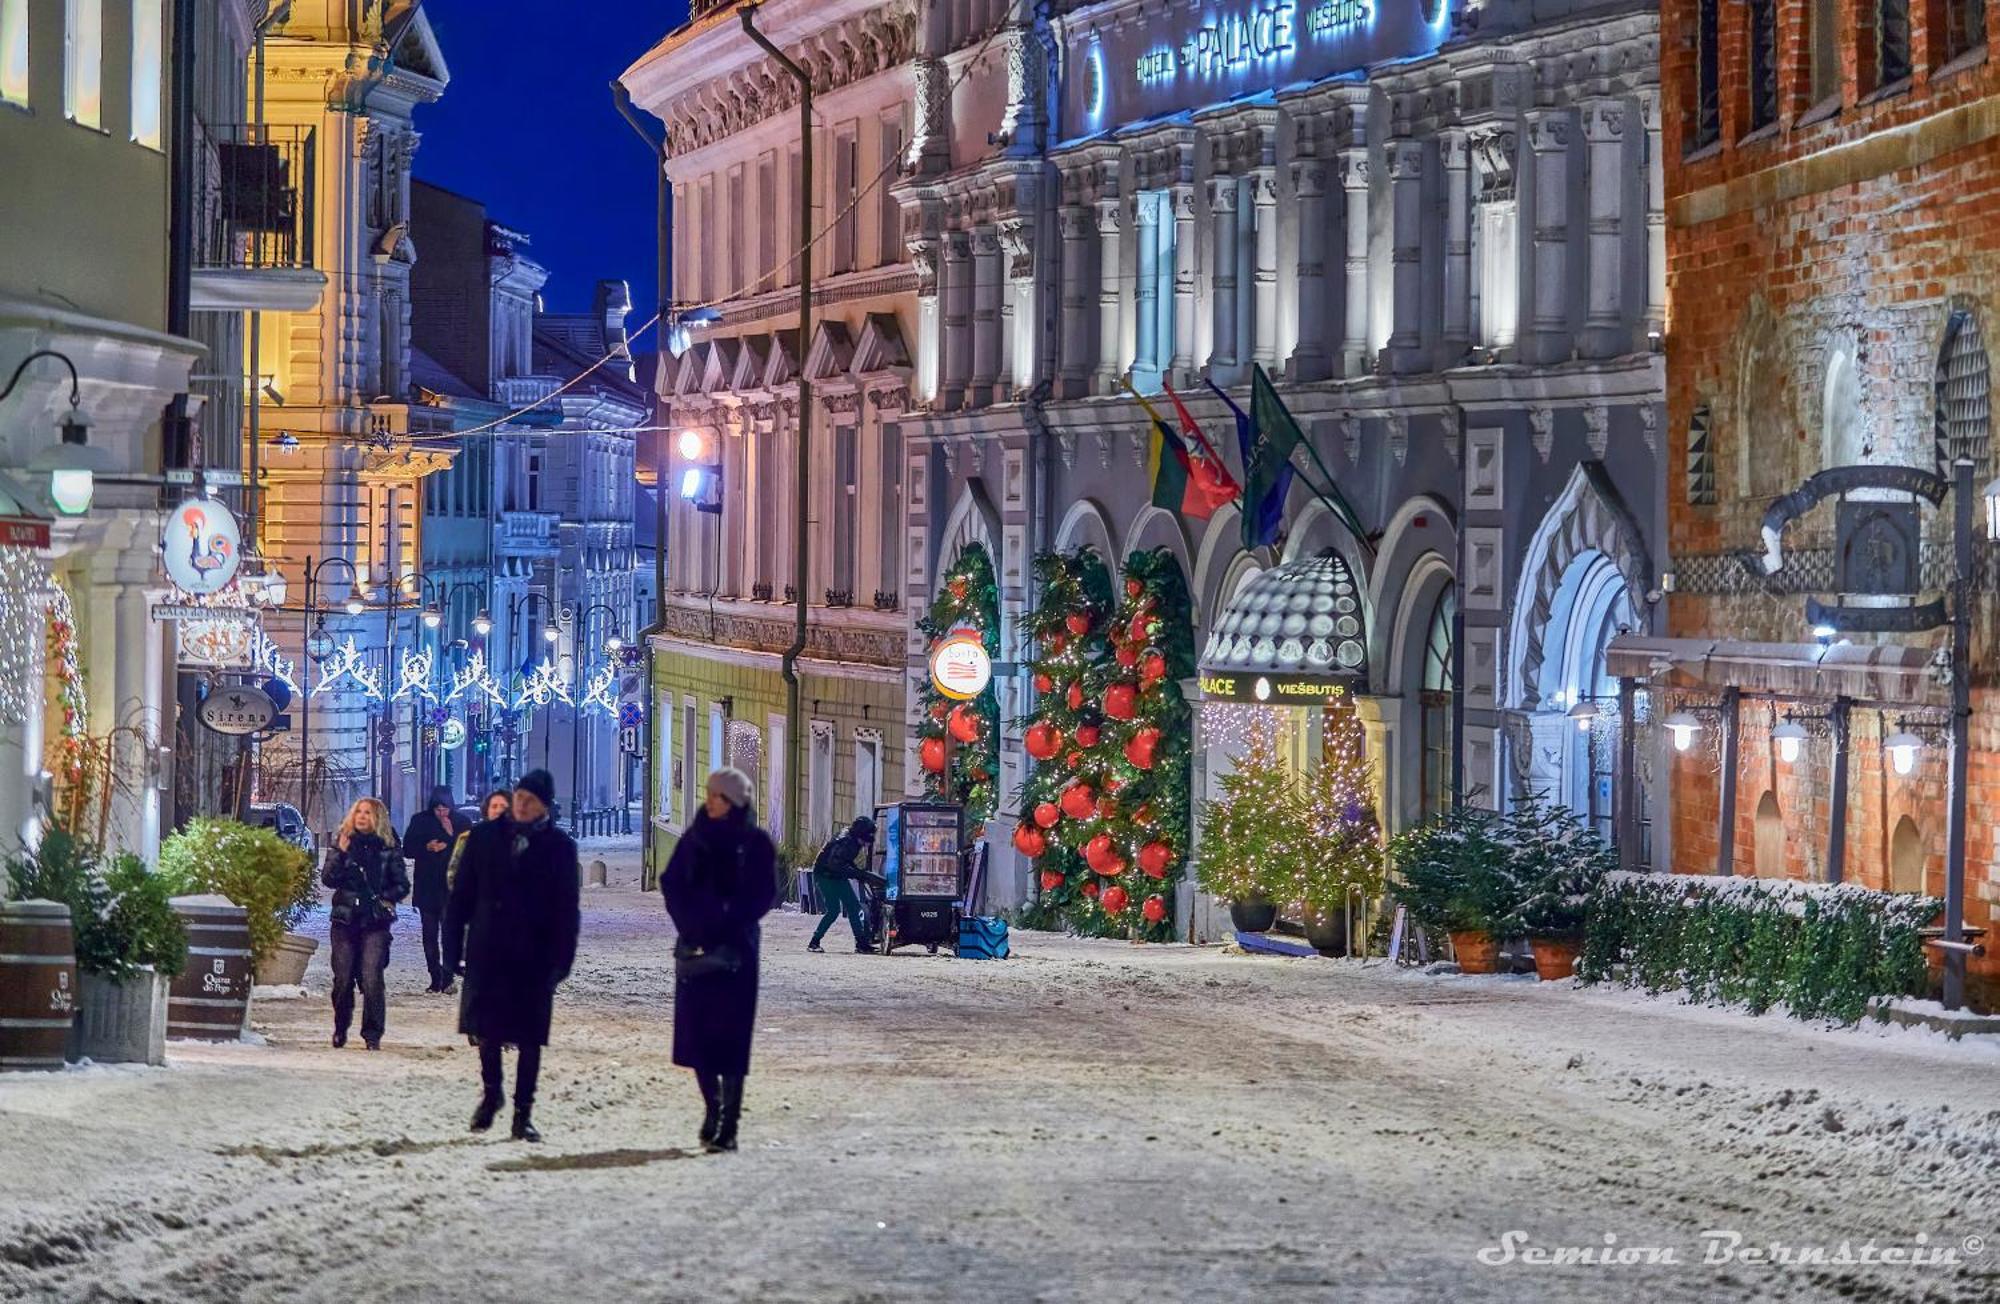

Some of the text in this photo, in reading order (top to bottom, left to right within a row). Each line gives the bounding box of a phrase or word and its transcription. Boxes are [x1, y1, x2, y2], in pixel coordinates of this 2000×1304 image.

[1135, 53, 1173, 80] HOTEL
[1197, 5, 1294, 73] PALACE
[1277, 682, 1345, 696] VIEŠBUTIS
[207, 709, 266, 722] Sirena
